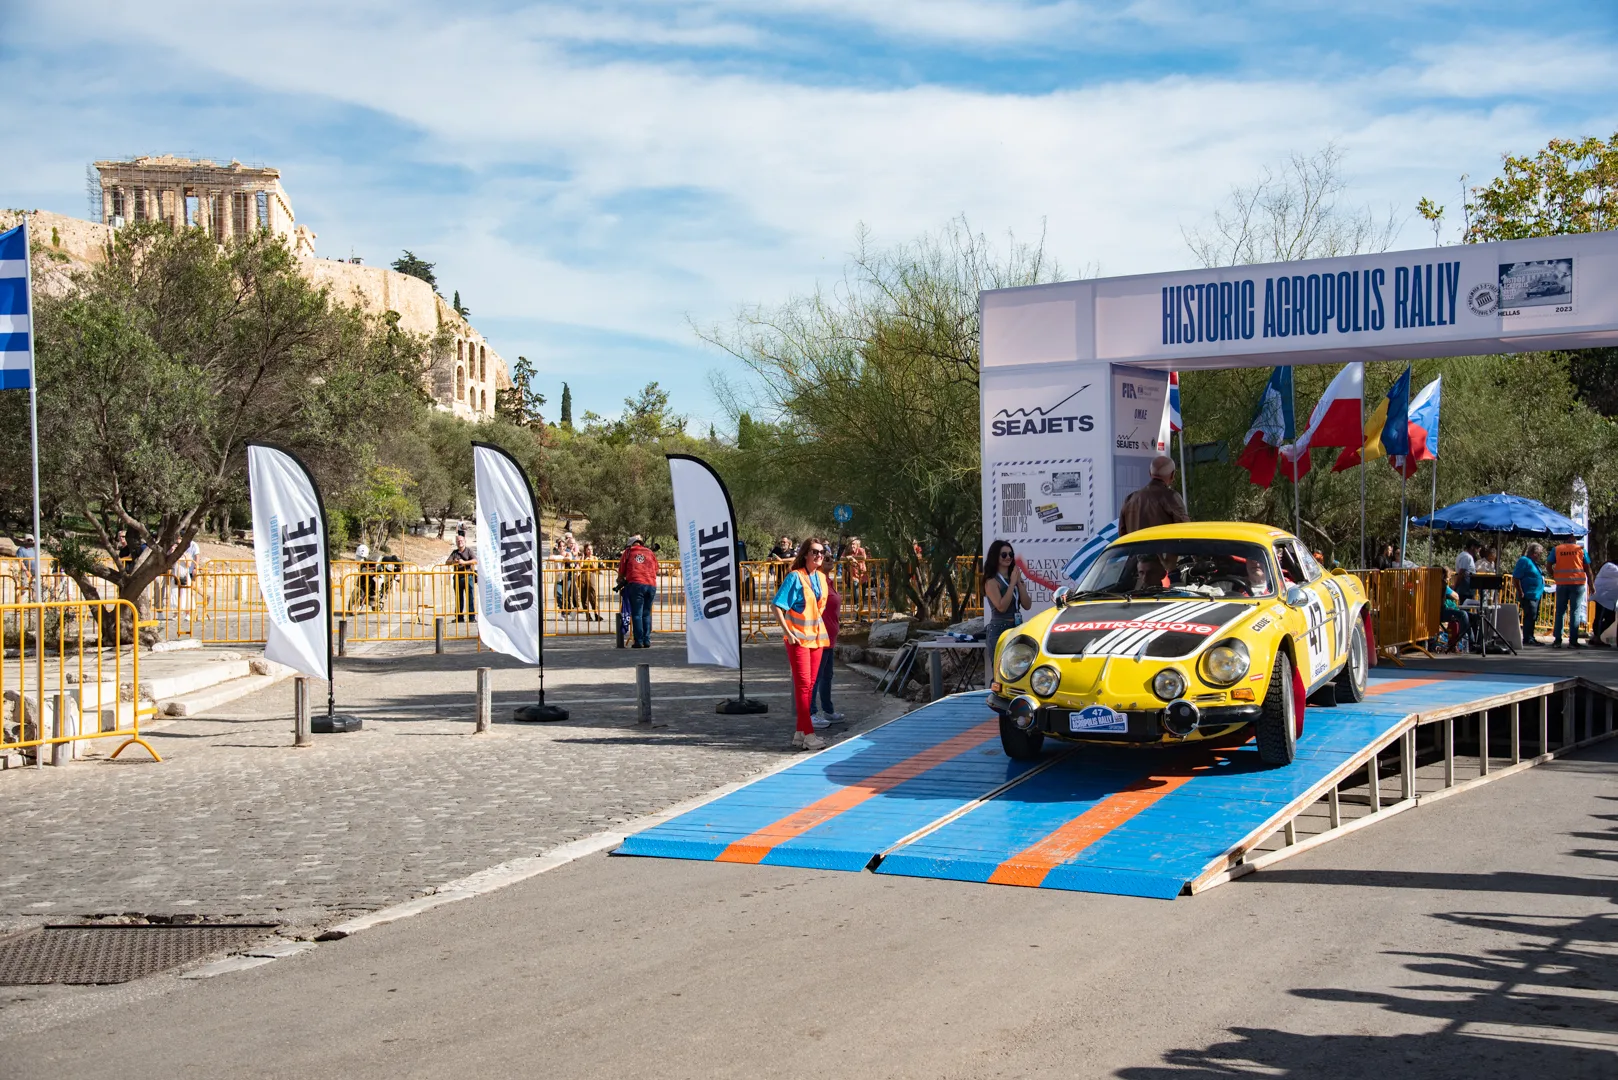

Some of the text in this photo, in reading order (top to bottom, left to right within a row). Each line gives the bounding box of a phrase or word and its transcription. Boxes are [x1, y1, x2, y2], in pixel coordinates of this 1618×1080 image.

[1162, 261, 1461, 345] HISTORIC ACROPOLIS RALLY
[1122, 382, 1137, 399] FIA
[991, 415, 1094, 436] SEAJETS
[1116, 440, 1139, 450] SEAJETS
[1002, 483, 1026, 499] HISTORIC
[1002, 499, 1032, 516] ACROPOLIS
[1003, 516, 1018, 533] RALLY
[1308, 601, 1323, 655] 47
[1091, 708, 1104, 716] 47
[1098, 714, 1113, 725] RALLY
